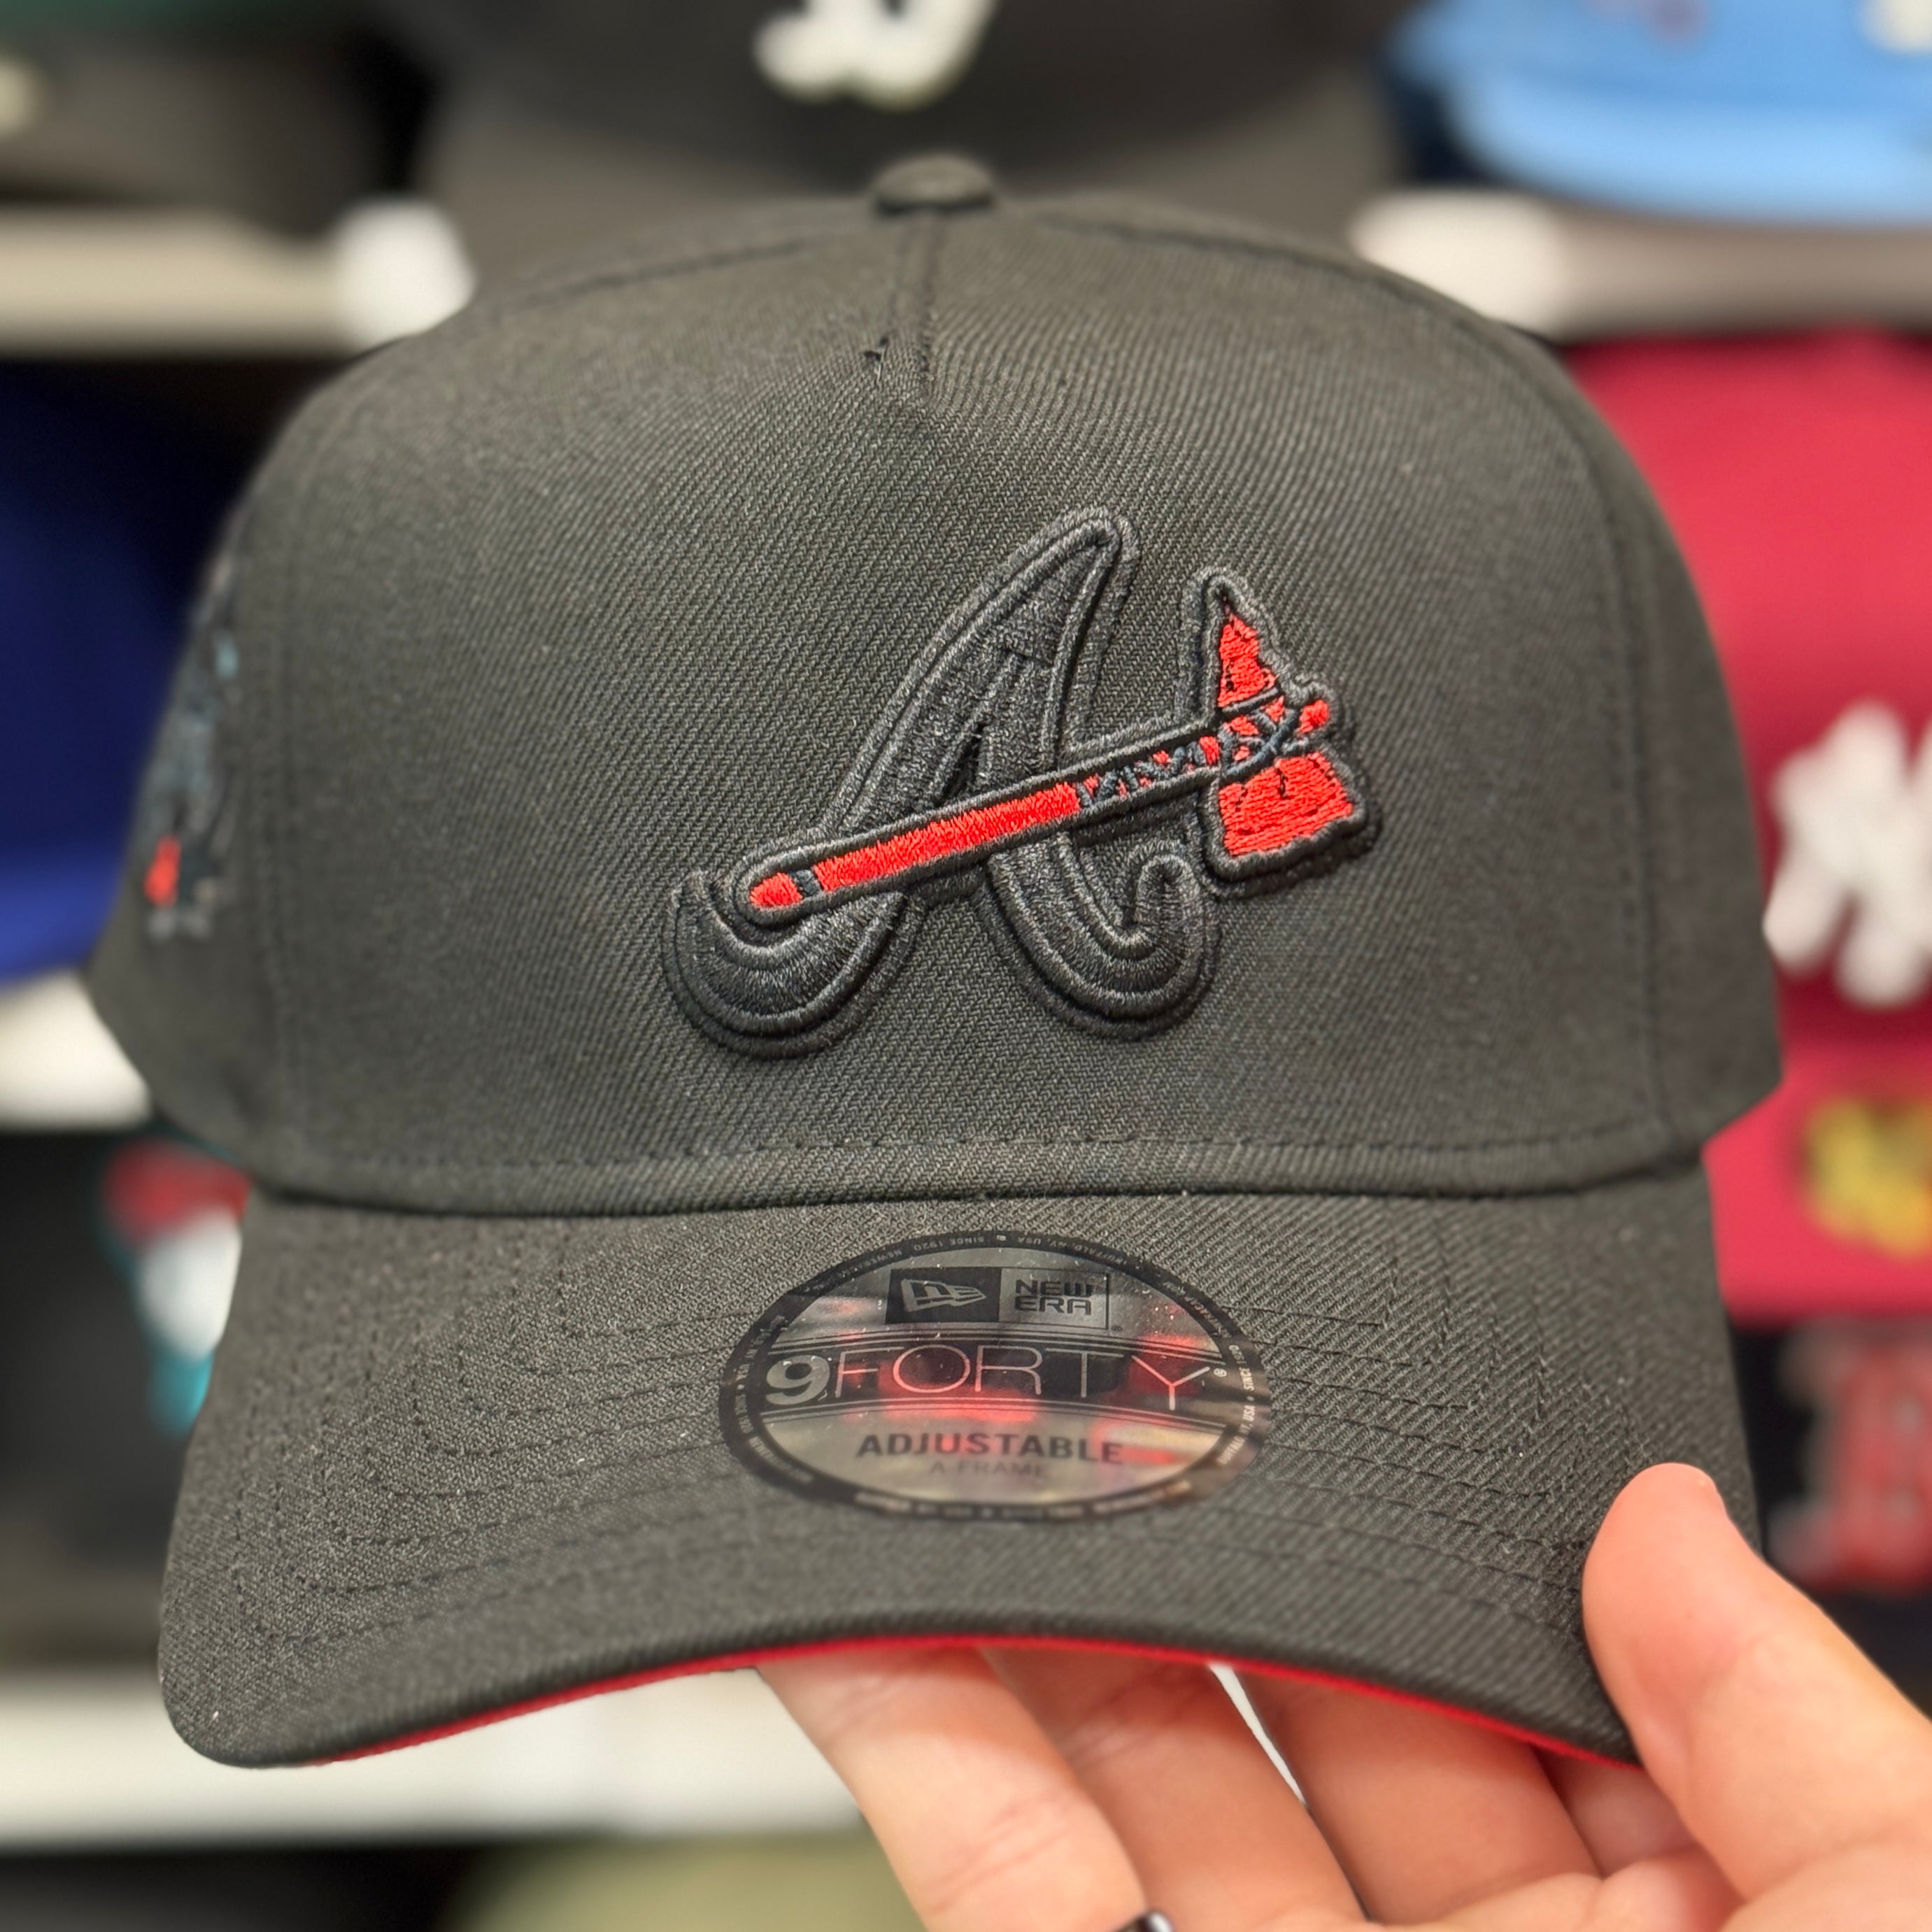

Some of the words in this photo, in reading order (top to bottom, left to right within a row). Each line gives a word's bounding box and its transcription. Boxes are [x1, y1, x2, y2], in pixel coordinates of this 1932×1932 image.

[1016, 1279, 1093, 1297] NEW
[1015, 1295, 1091, 1315] ERA
[1229, 1344, 1247, 1364] 1920
[766, 1344, 1210, 1410] 9FORTY
[1239, 1367, 1254, 1391] SINCE
[1242, 1405, 1256, 1422] USA
[856, 1432, 1124, 1465] ADJUSTABLE
